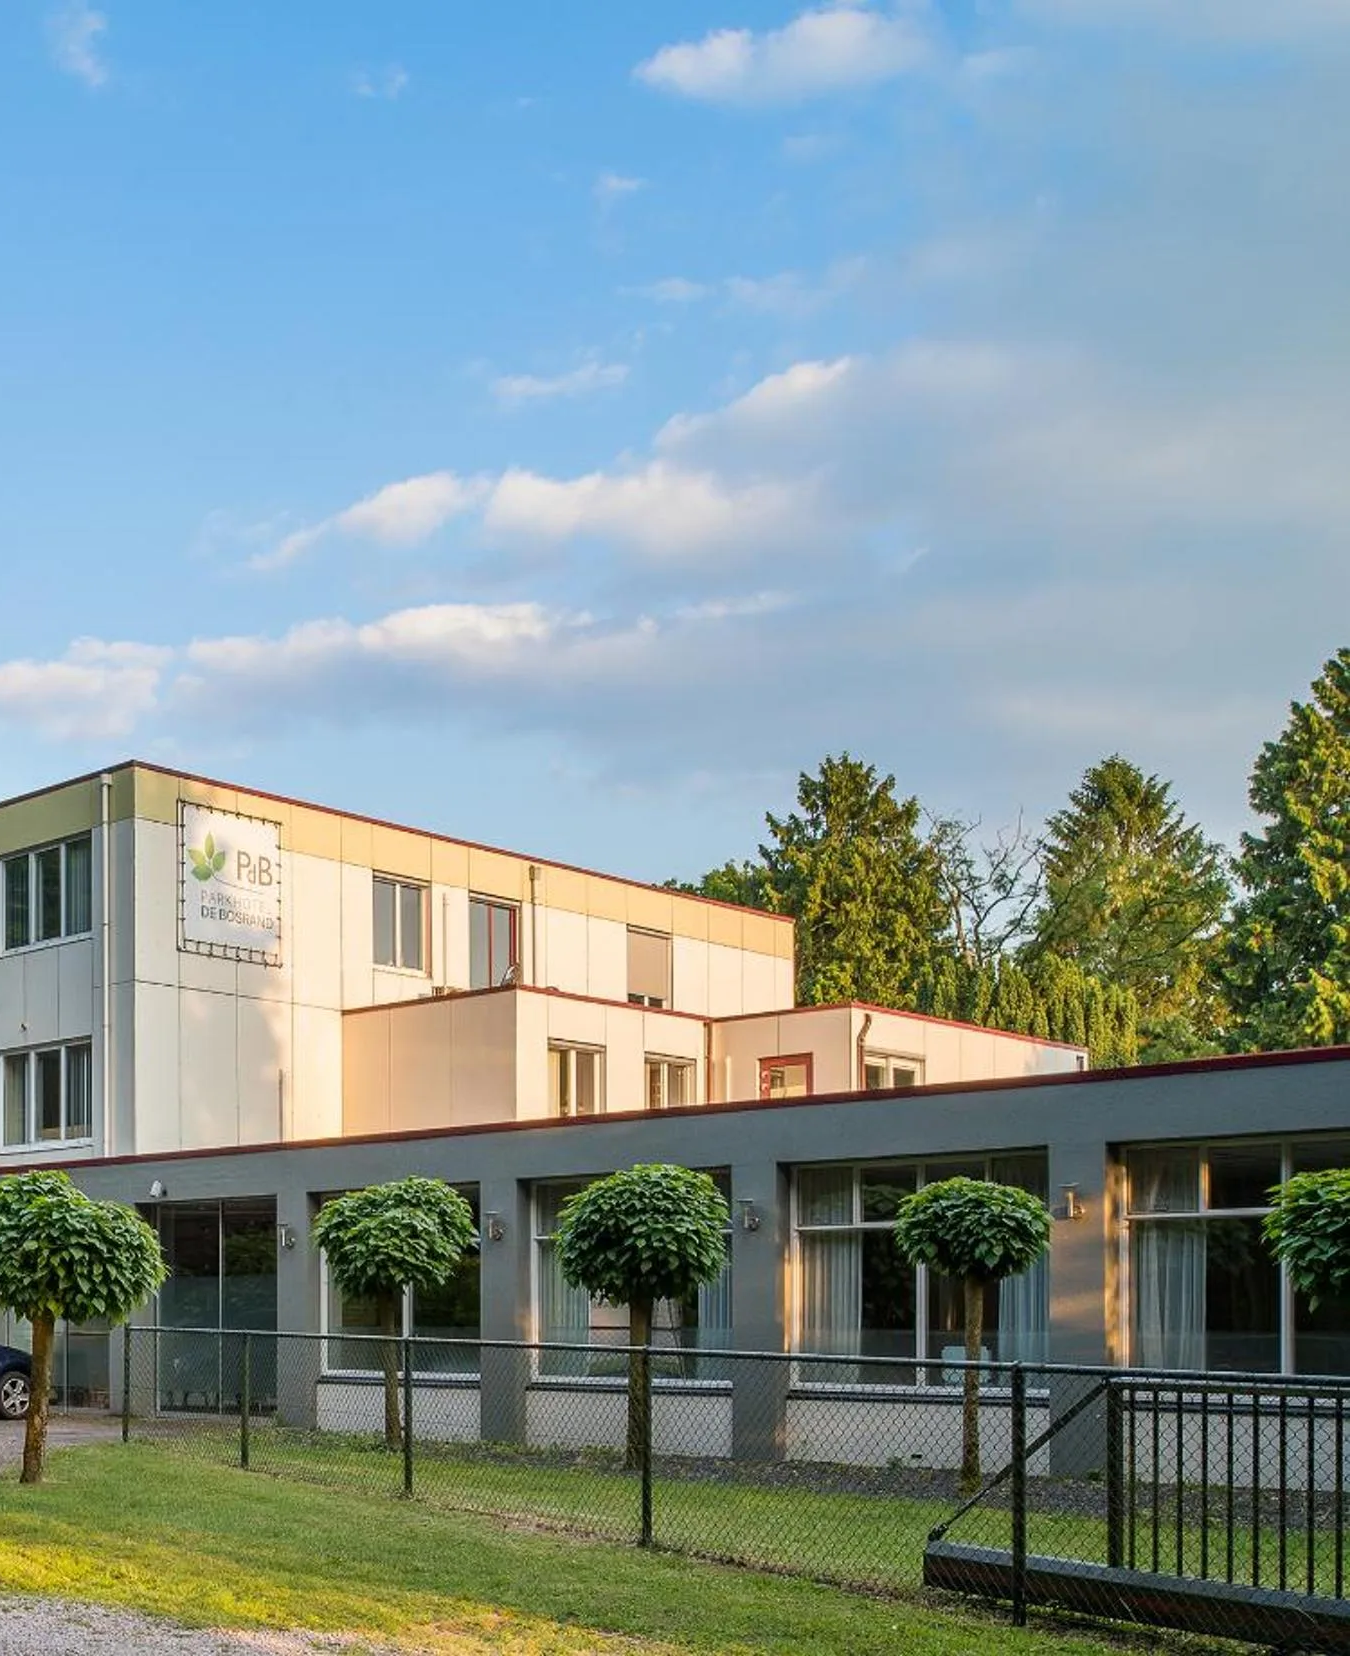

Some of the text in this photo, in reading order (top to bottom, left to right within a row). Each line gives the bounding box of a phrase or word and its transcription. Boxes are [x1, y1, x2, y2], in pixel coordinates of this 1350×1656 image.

[237, 850, 273, 886] PdB
[201, 890, 272, 914] PARKHOTE
[201, 905, 274, 929] DE BOSRAND
